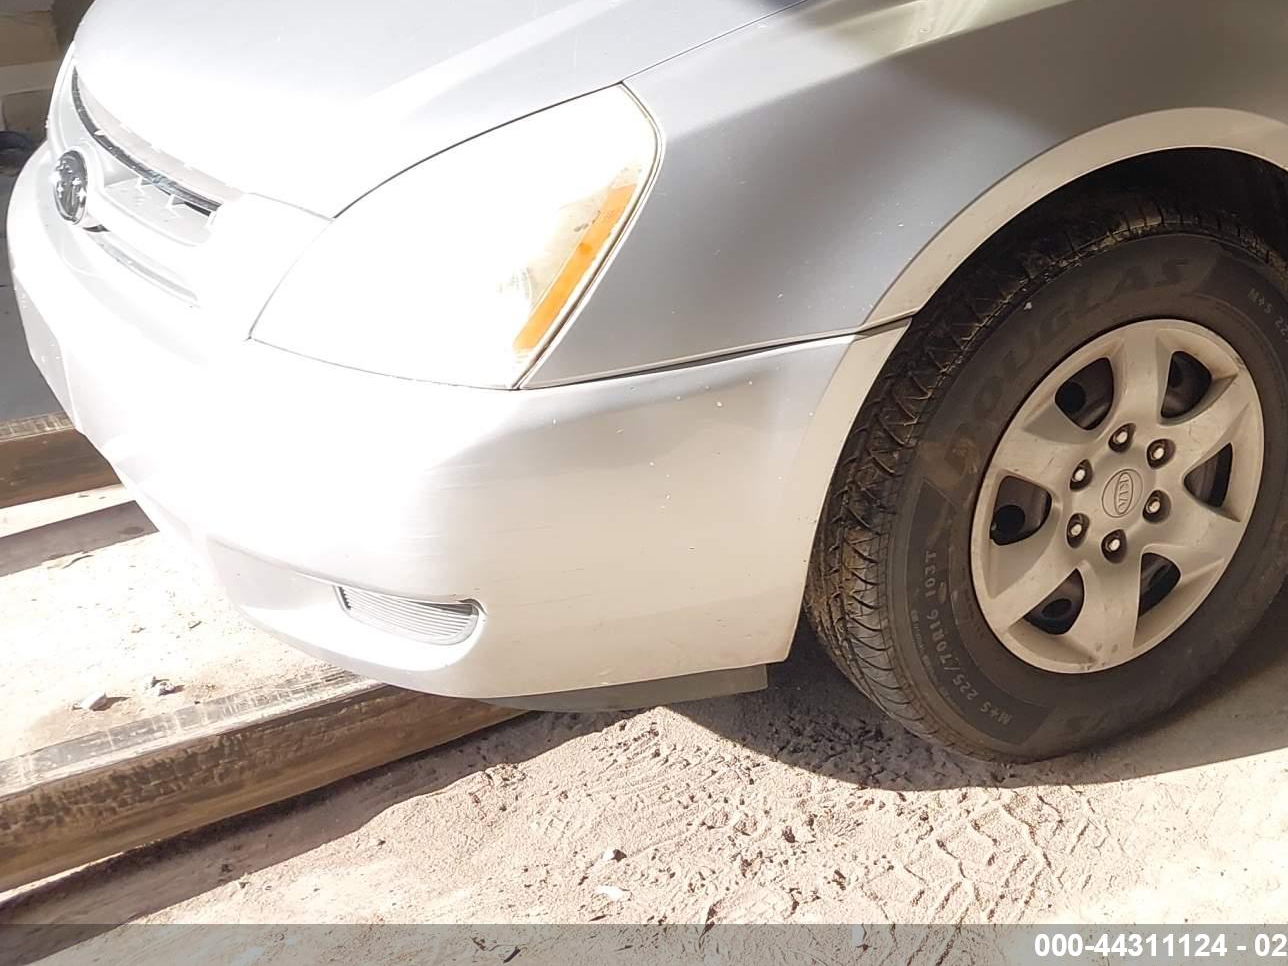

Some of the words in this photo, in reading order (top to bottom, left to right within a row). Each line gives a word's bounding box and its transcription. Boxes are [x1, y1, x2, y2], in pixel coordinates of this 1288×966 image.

[923, 550, 937, 598] 103T
[926, 608, 979, 701] 225/70R16
[979, 700, 1013, 726] M+S
